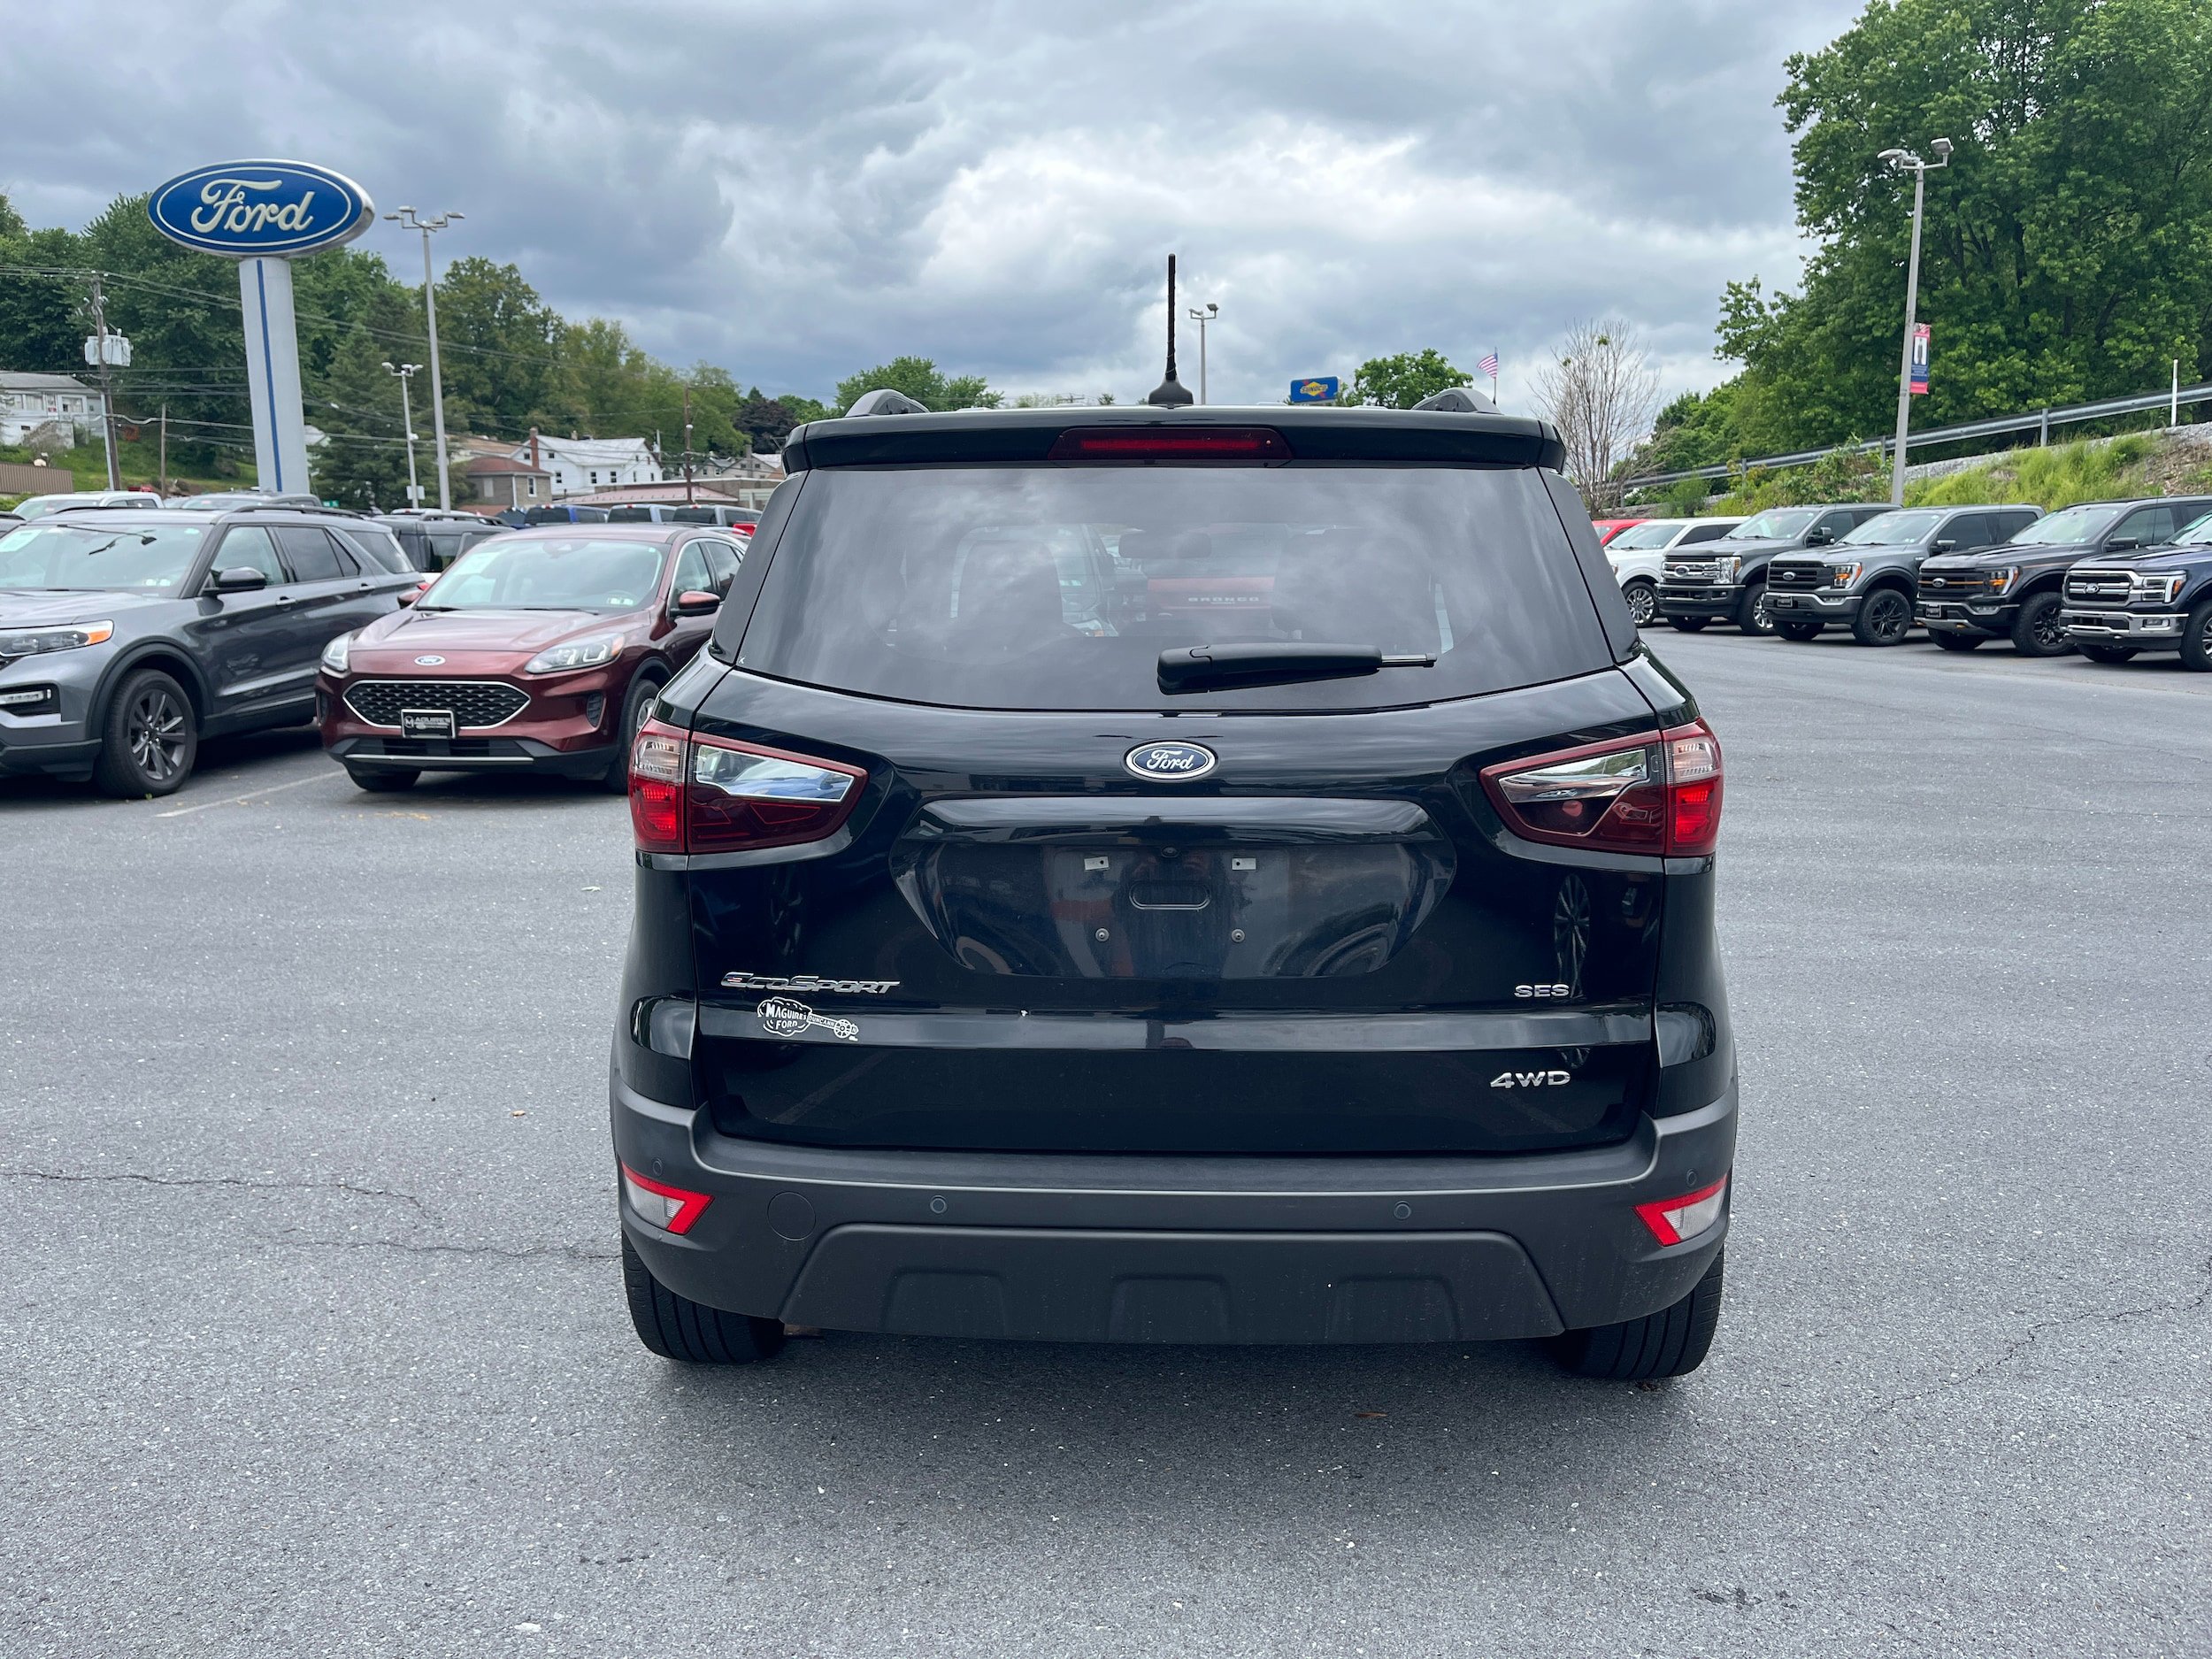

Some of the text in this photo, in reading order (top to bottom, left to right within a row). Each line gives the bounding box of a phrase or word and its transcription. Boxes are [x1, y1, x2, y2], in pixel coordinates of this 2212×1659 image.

[190, 178, 315, 234] Ford
[1146, 749, 1194, 770] Ford
[1514, 984, 1570, 998] SES
[775, 1019, 798, 1030] FORD
[1490, 1071, 1571, 1088] 4WD
